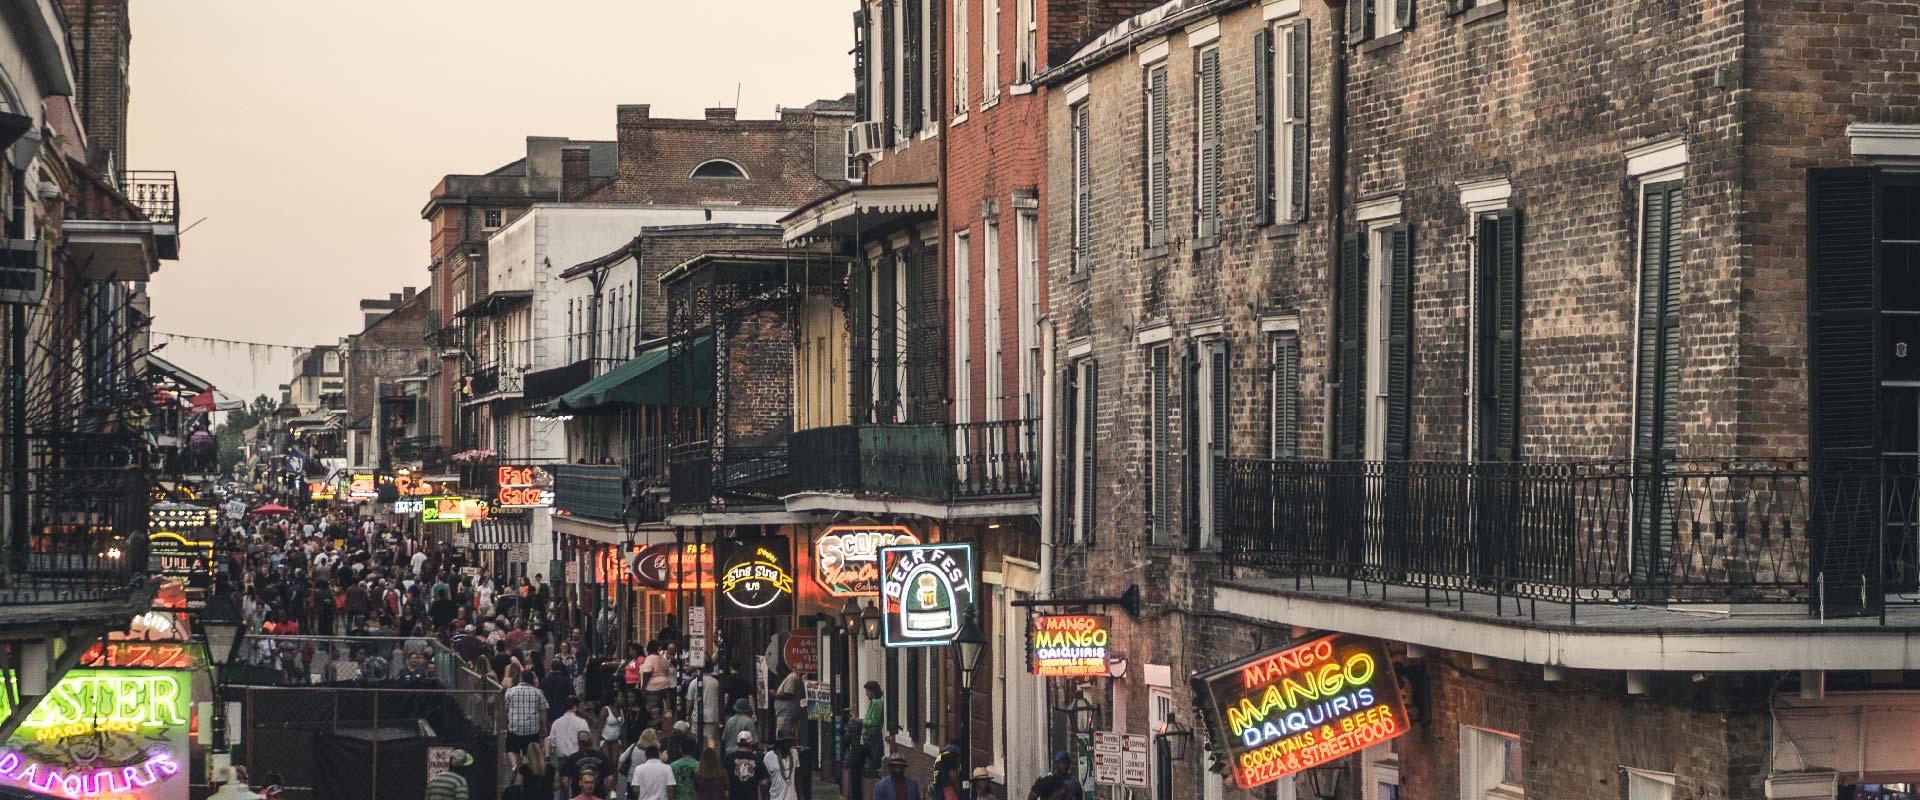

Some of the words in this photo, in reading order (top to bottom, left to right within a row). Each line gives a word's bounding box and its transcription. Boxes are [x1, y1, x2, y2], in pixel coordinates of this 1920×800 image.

[499, 466, 532, 485] Fat
[820, 533, 917, 570] SCOR
[729, 566, 752, 583] Sing
[755, 565, 778, 581] Sing
[887, 549, 926, 598] BEER
[930, 549, 970, 592] FEST
[1046, 617, 1095, 630] MANGO
[1036, 629, 1107, 648] MANGO
[1039, 647, 1105, 659] DAIQUIRIS
[1245, 640, 1332, 688] MANGO
[1227, 653, 1375, 736] MANGO
[1243, 687, 1375, 747] DAIQUIRIS
[36, 723, 91, 741] MARDI
[1104, 735, 1118, 743] PARKING
[1242, 731, 1315, 768] COCKTAILS
[1321, 725, 1334, 740] &
[1342, 705, 1392, 732] BEER
[1104, 757, 1119, 765] PARKING
[1125, 760, 1145, 768] CORNER
[1245, 761, 1288, 785] PIZZA
[1288, 753, 1301, 770] &
[1125, 769, 1145, 777] ANYTIME
